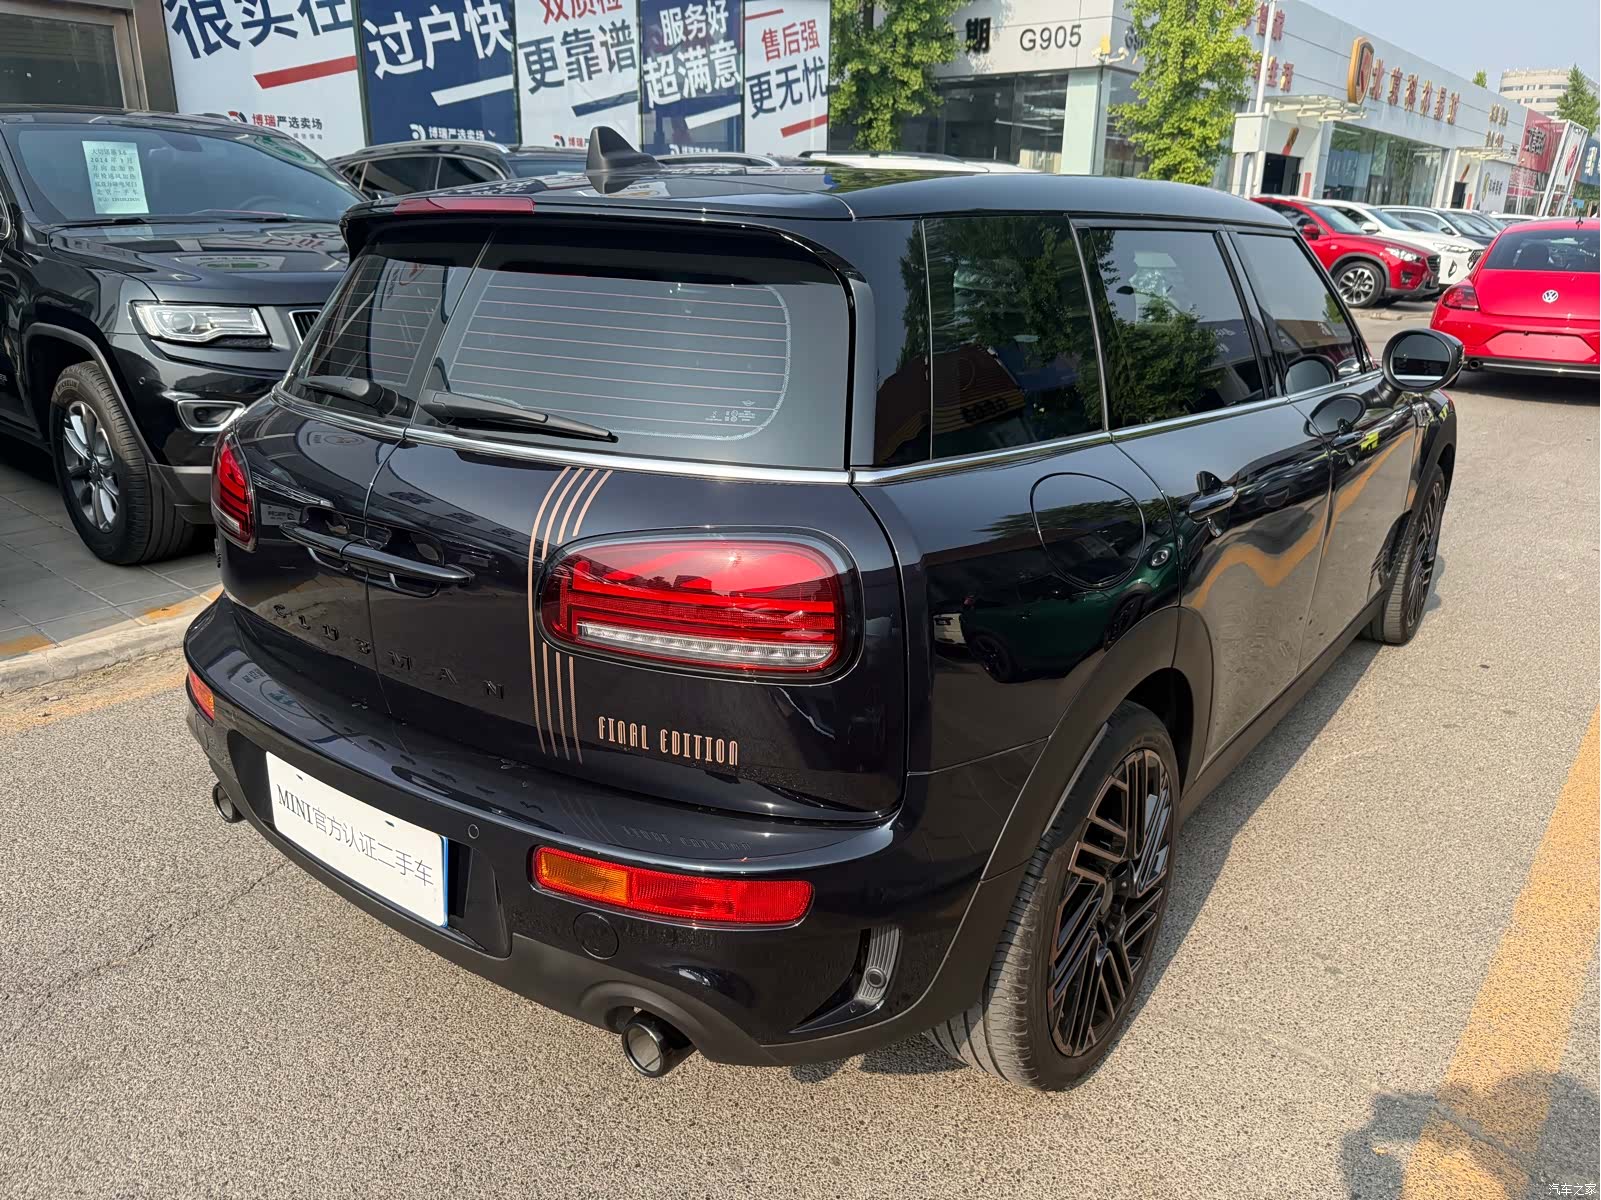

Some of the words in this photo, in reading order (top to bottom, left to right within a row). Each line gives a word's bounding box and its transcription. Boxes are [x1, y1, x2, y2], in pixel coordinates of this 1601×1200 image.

[362, 0, 514, 80] 过户快
[659, 0, 729, 47] 服务好
[761, 19, 821, 63] 售后强
[1019, 24, 1082, 52] G905
[518, 19, 637, 95] 更靠谱
[642, 39, 741, 110] 超满意
[745, 55, 828, 119] 更无忧
[252, 113, 323, 130] 博瑞严选卖场
[598, 716, 650, 750] FINAL
[660, 729, 739, 766] EDITION
